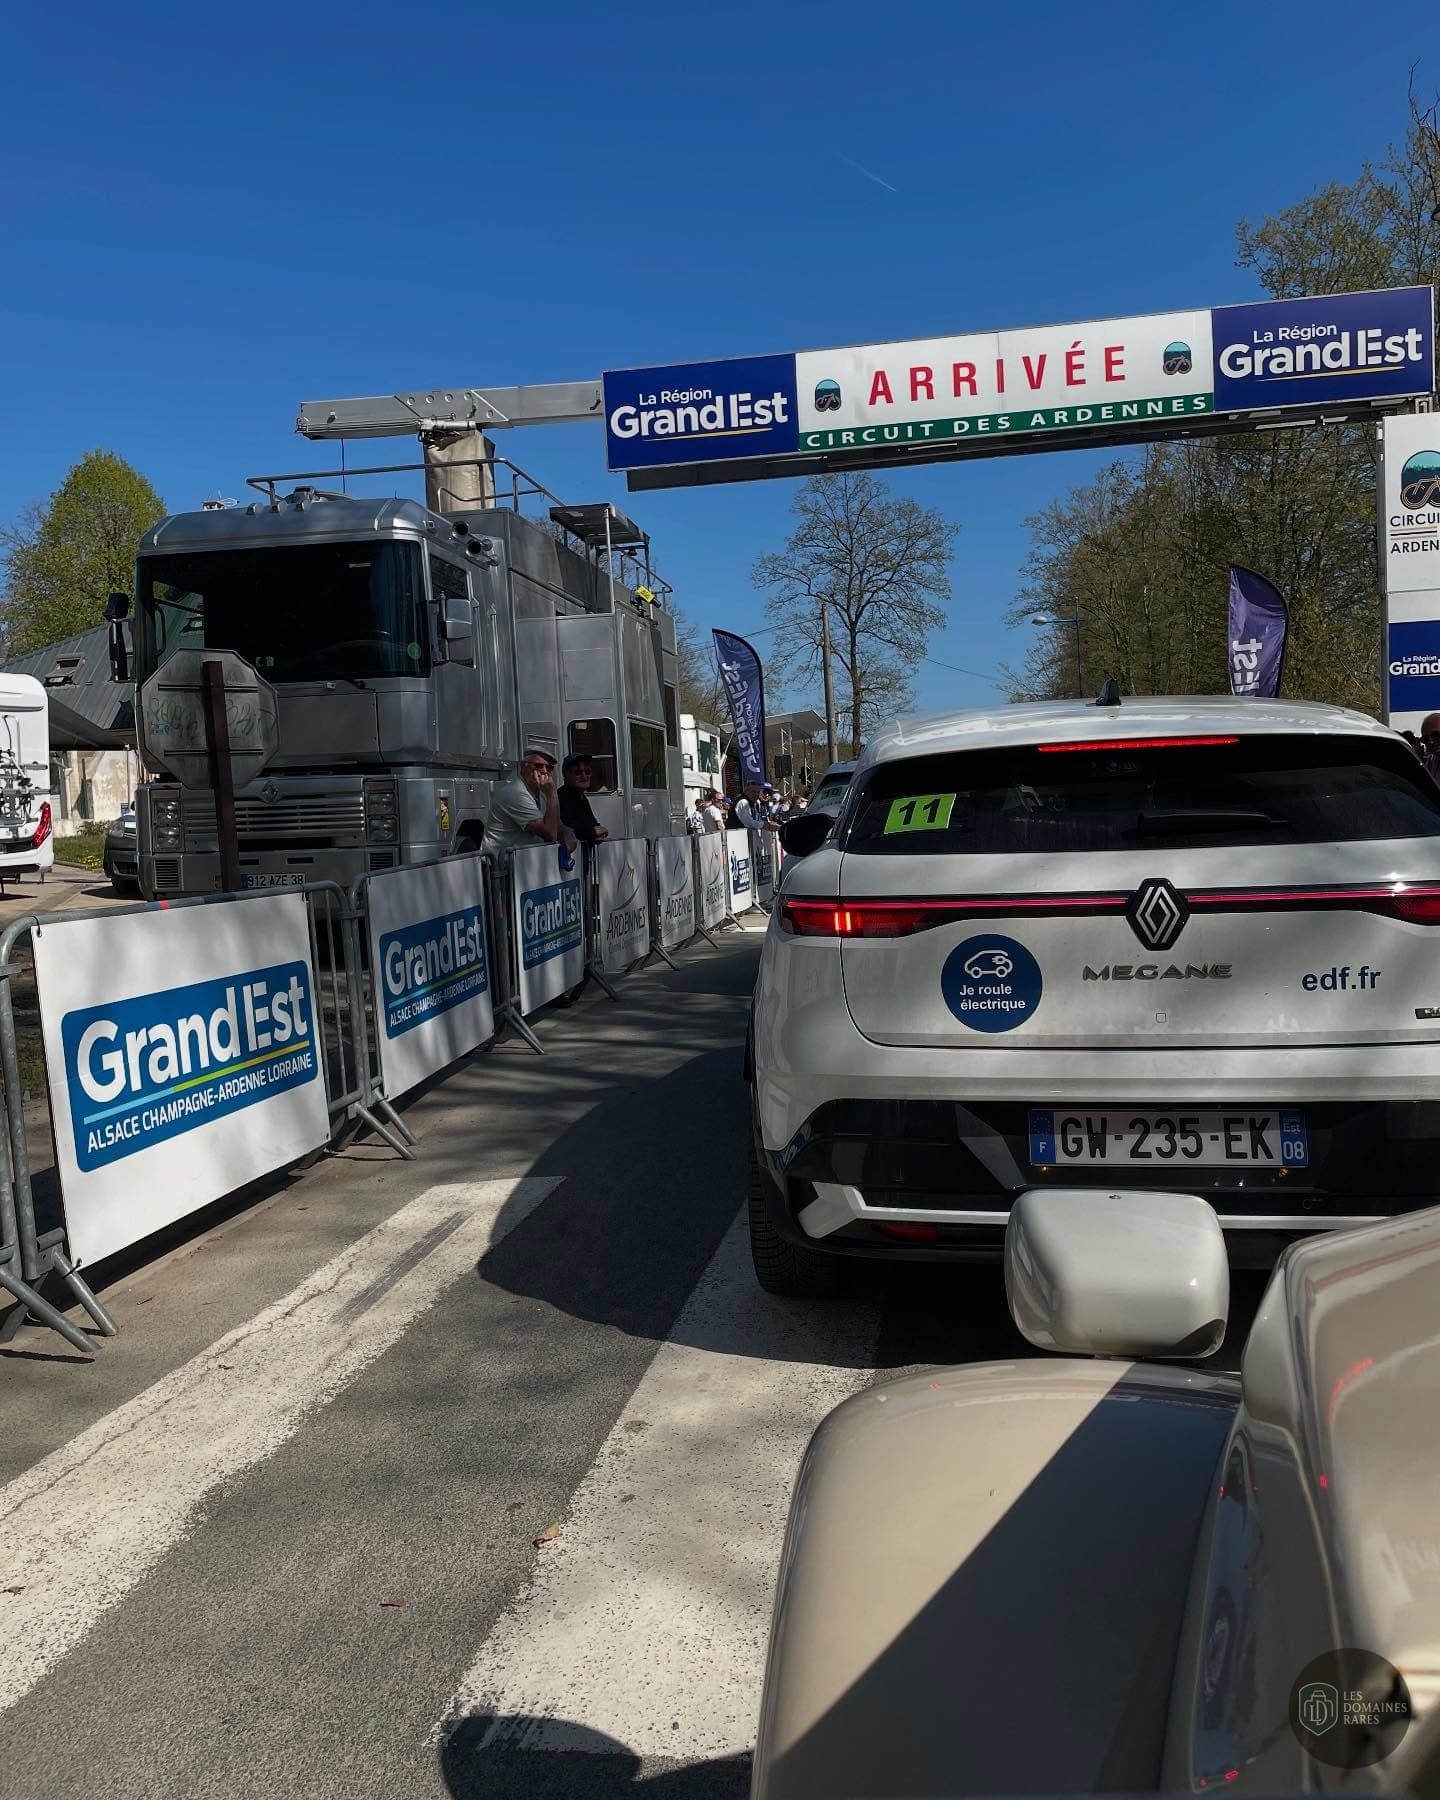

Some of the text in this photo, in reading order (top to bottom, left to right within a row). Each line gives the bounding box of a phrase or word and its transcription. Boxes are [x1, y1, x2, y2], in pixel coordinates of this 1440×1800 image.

[1253, 323, 1338, 343] La Région
[868, 340, 1126, 406] ARRIVÉE
[639, 387, 712, 406] La Région
[806, 396, 1207, 448] CIRCUIT DES ARDENNES
[898, 799, 941, 826] 11
[248, 876, 267, 887] 912
[270, 875, 288, 886] AZE
[606, 906, 646, 941] ARDENNES
[1082, 963, 1233, 982] MEGANE
[1302, 966, 1382, 992] edf.fr
[959, 983, 1012, 996] Je roule
[960, 997, 1026, 1012] électrique
[87, 1053, 312, 1153] ALSACE CHAMPAGNE-ARDENNE LORRAINE
[1039, 1116, 1304, 1160] F GW-235-EK 08
